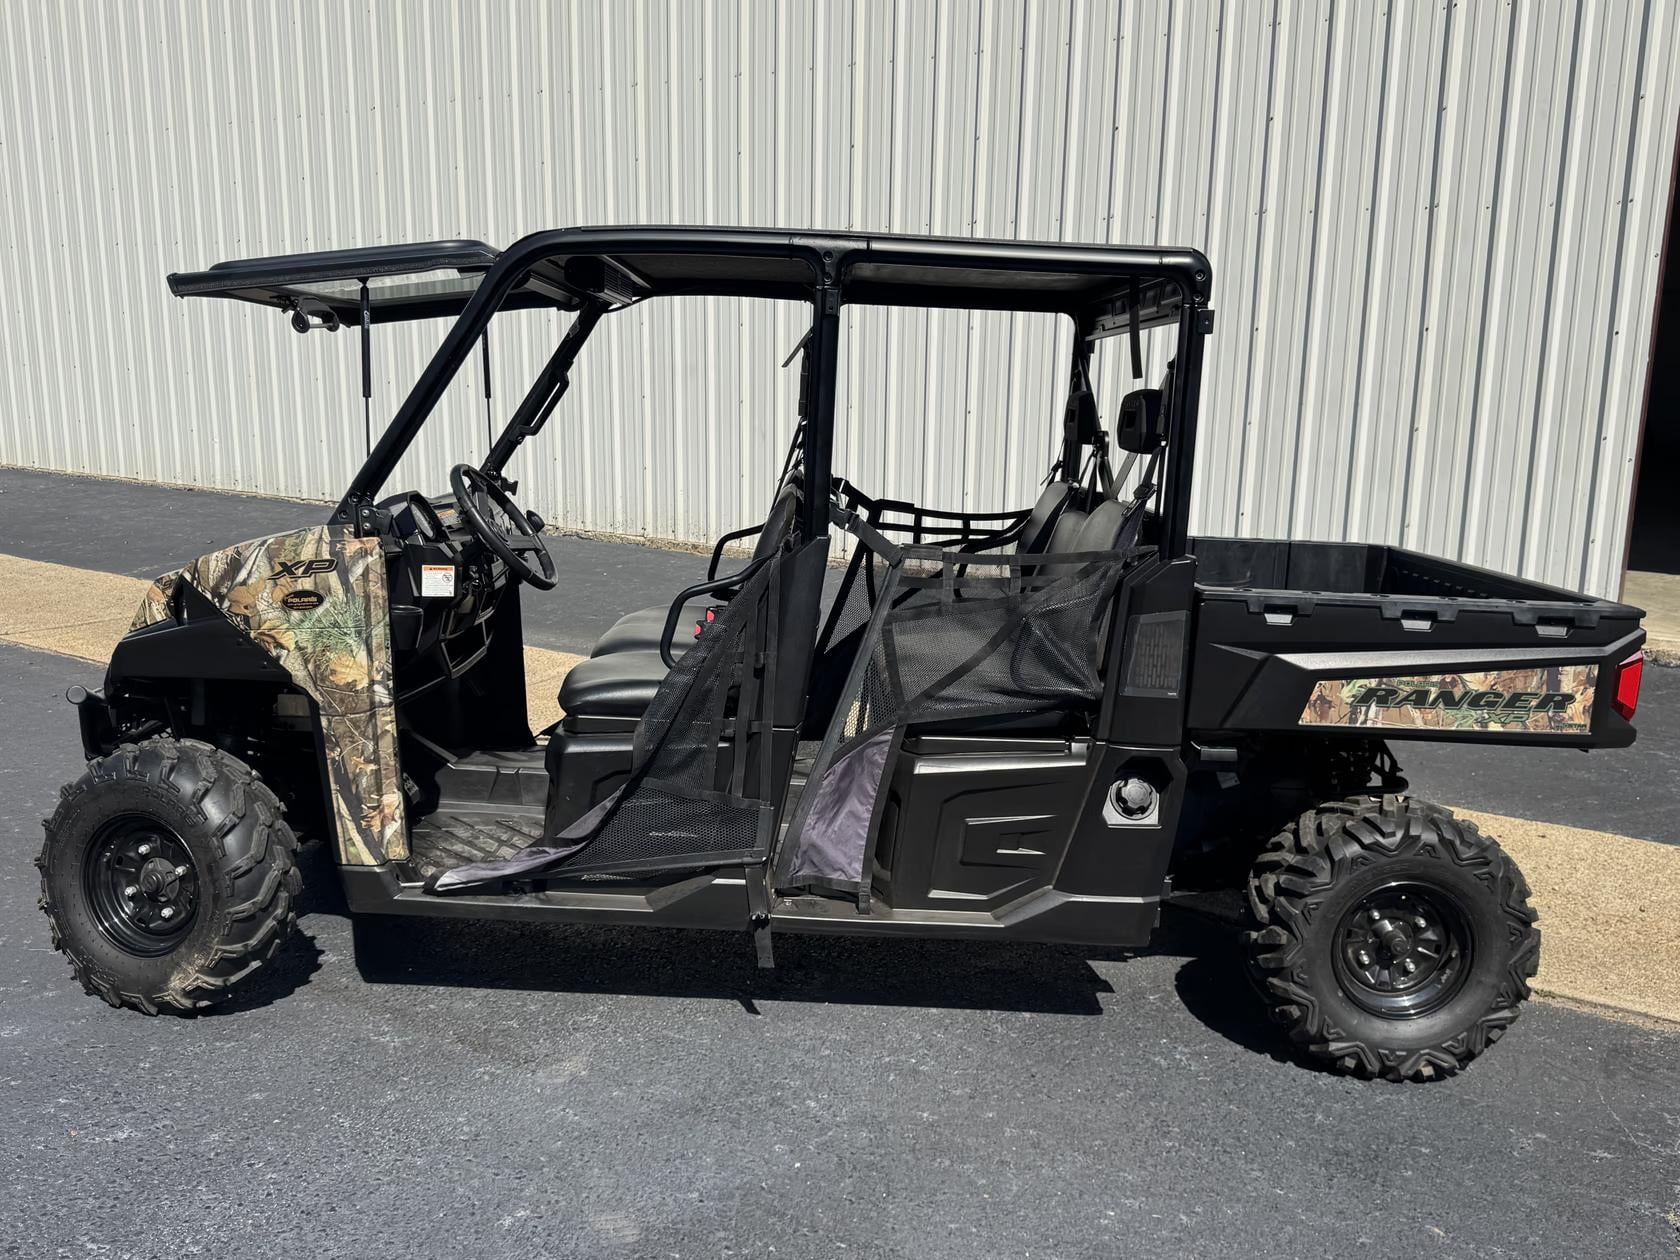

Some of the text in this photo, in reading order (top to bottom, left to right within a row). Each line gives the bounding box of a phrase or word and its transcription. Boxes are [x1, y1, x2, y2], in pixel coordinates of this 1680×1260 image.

[267, 559, 337, 580] XP
[1397, 680, 1440, 688] POLARIS
[1350, 687, 1577, 713] RANGER
[1478, 712, 1529, 723] XP
